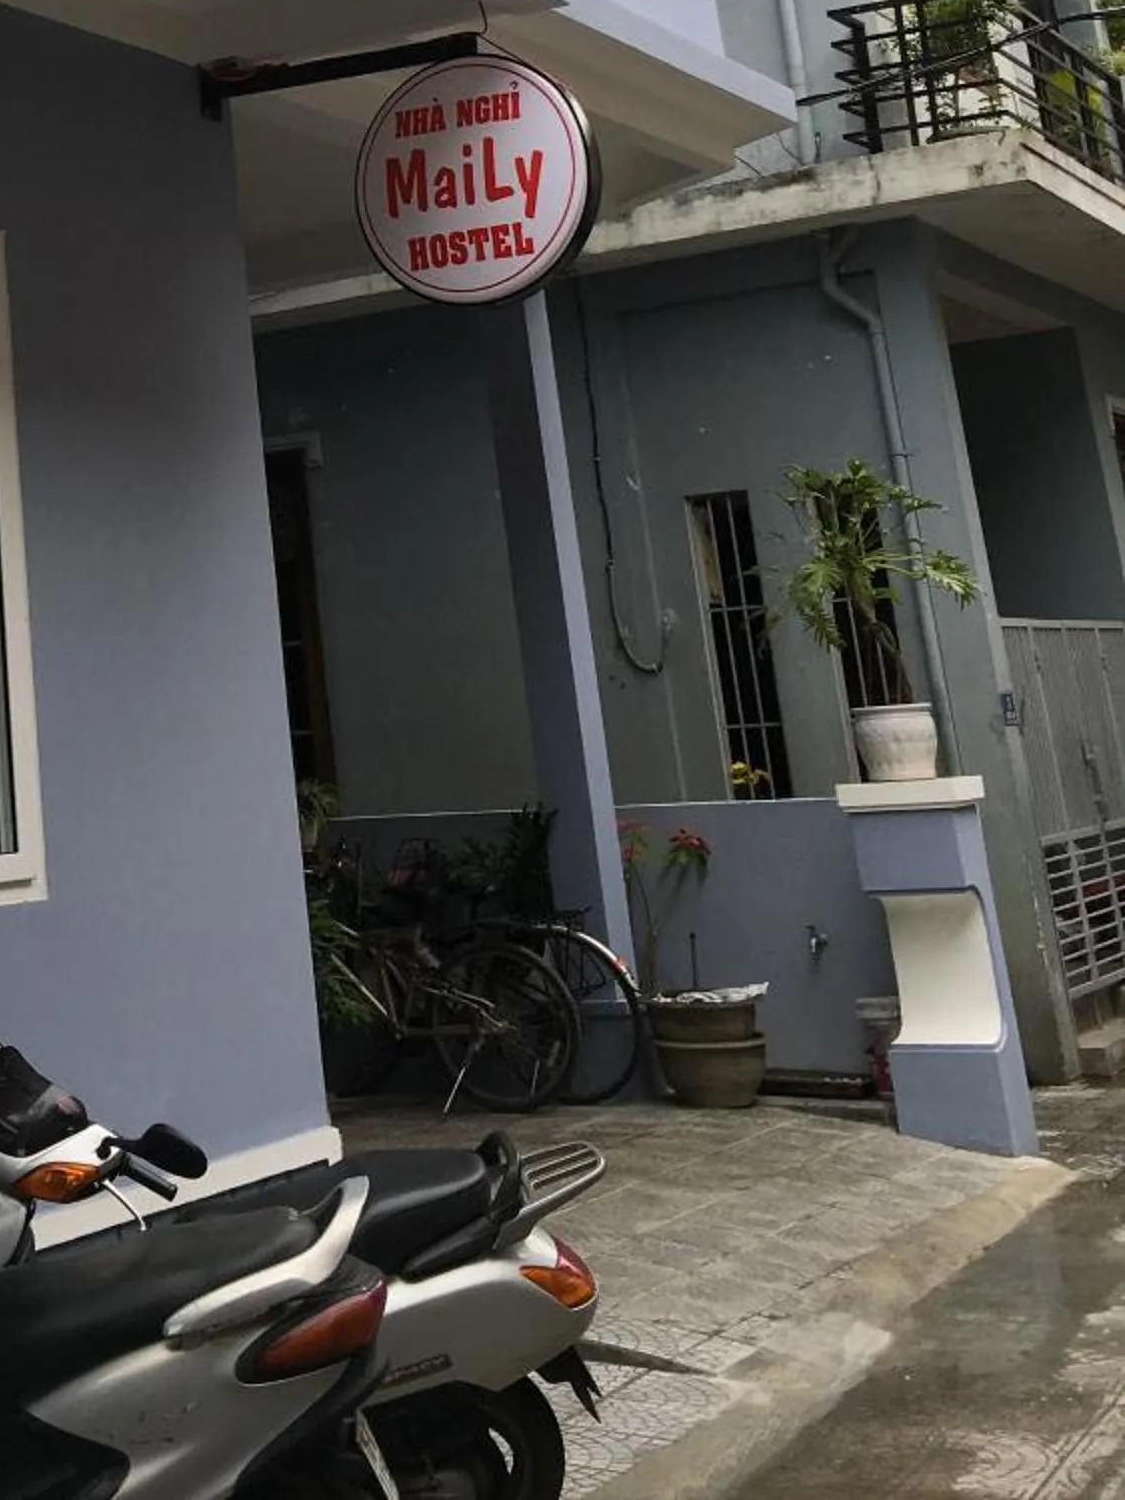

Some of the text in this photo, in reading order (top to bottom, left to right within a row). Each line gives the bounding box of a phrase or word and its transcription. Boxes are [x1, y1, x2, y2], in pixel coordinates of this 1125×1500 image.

[395, 81, 520, 138] NHÀ NGHỈ
[408, 222, 534, 271] HOSTEL
